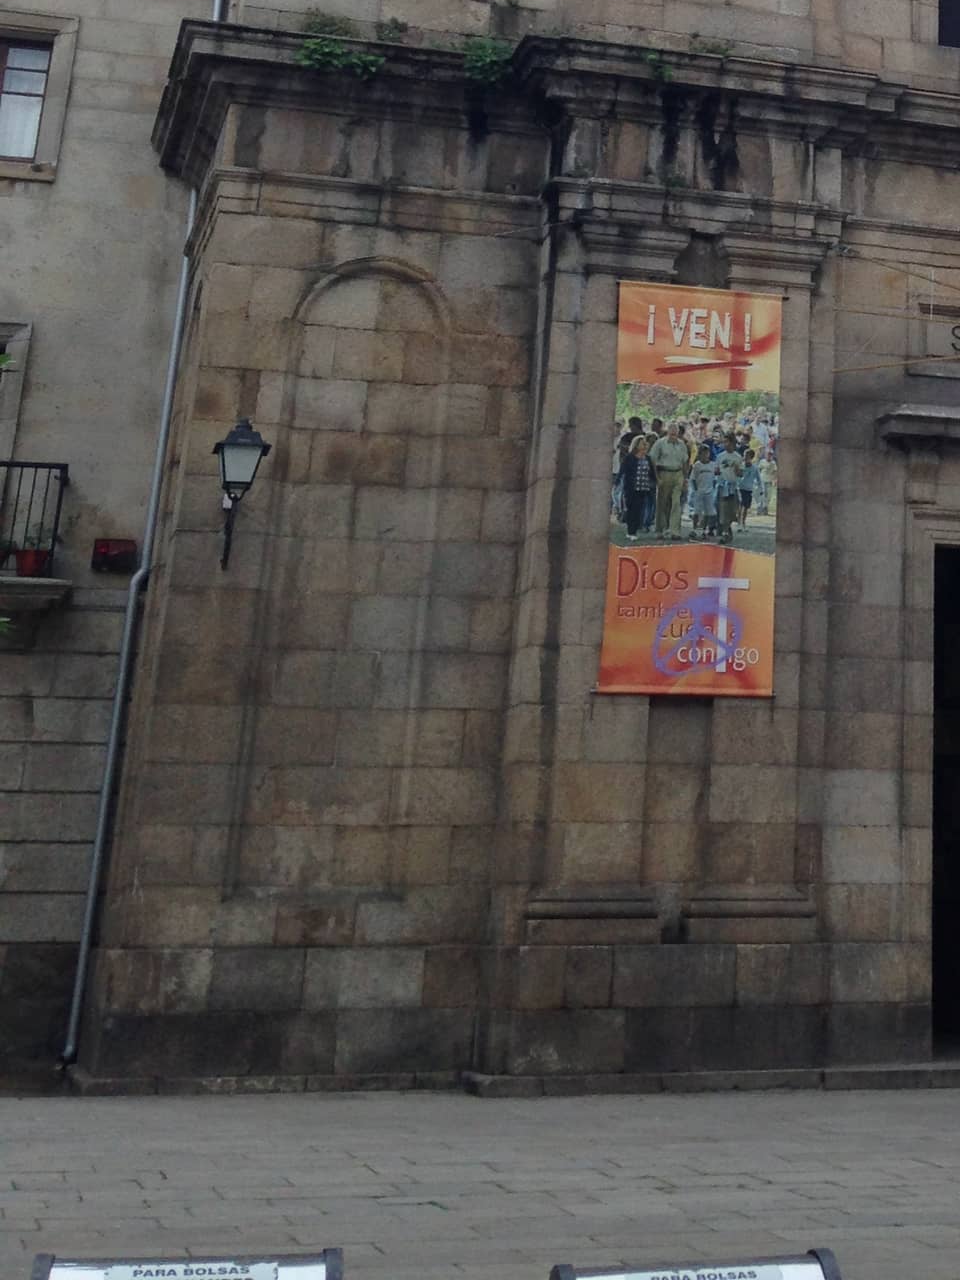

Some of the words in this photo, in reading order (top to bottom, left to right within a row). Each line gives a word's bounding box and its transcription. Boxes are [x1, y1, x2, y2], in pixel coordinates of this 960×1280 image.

[668, 307, 732, 349] VEN
[616, 555, 690, 598] Dios
[133, 1269, 177, 1277] PARA
[183, 1266, 250, 1276] BOLSAS
[696, 1270, 757, 1280] BOLSAS
